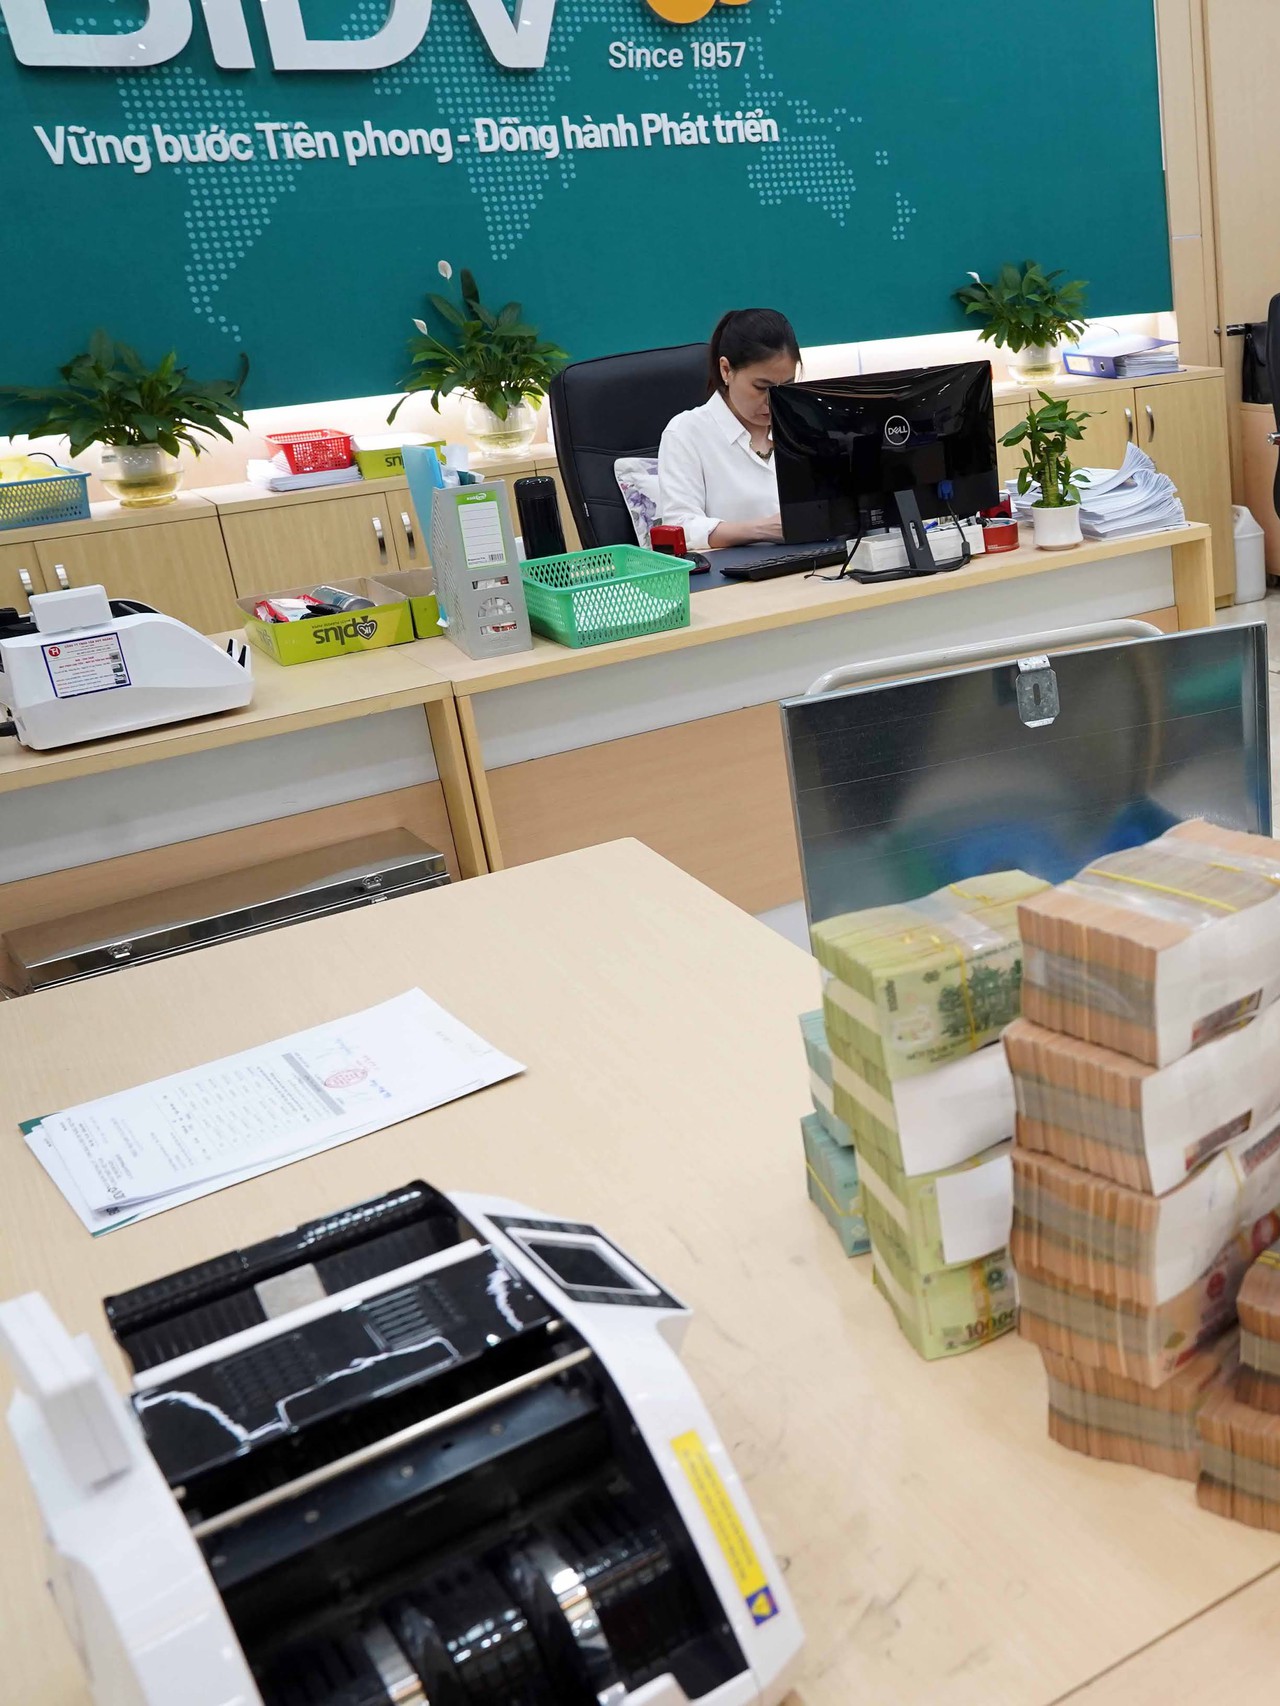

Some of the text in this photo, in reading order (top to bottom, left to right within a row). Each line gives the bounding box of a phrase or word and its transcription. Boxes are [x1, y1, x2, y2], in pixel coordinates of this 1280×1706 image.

[608, 41, 747, 69] Since 1957
[33, 124, 153, 174] Vững
[153, 123, 254, 164] bước
[255, 121, 340, 161] Tiên
[343, 120, 454, 166] phong
[474, 115, 559, 159] Đồng
[561, 114, 638, 151] hành
[640, 112, 711, 146] Phát
[712, 108, 779, 144] triển
[888, 425, 908, 435] DELL
[312, 618, 359, 645] plus
